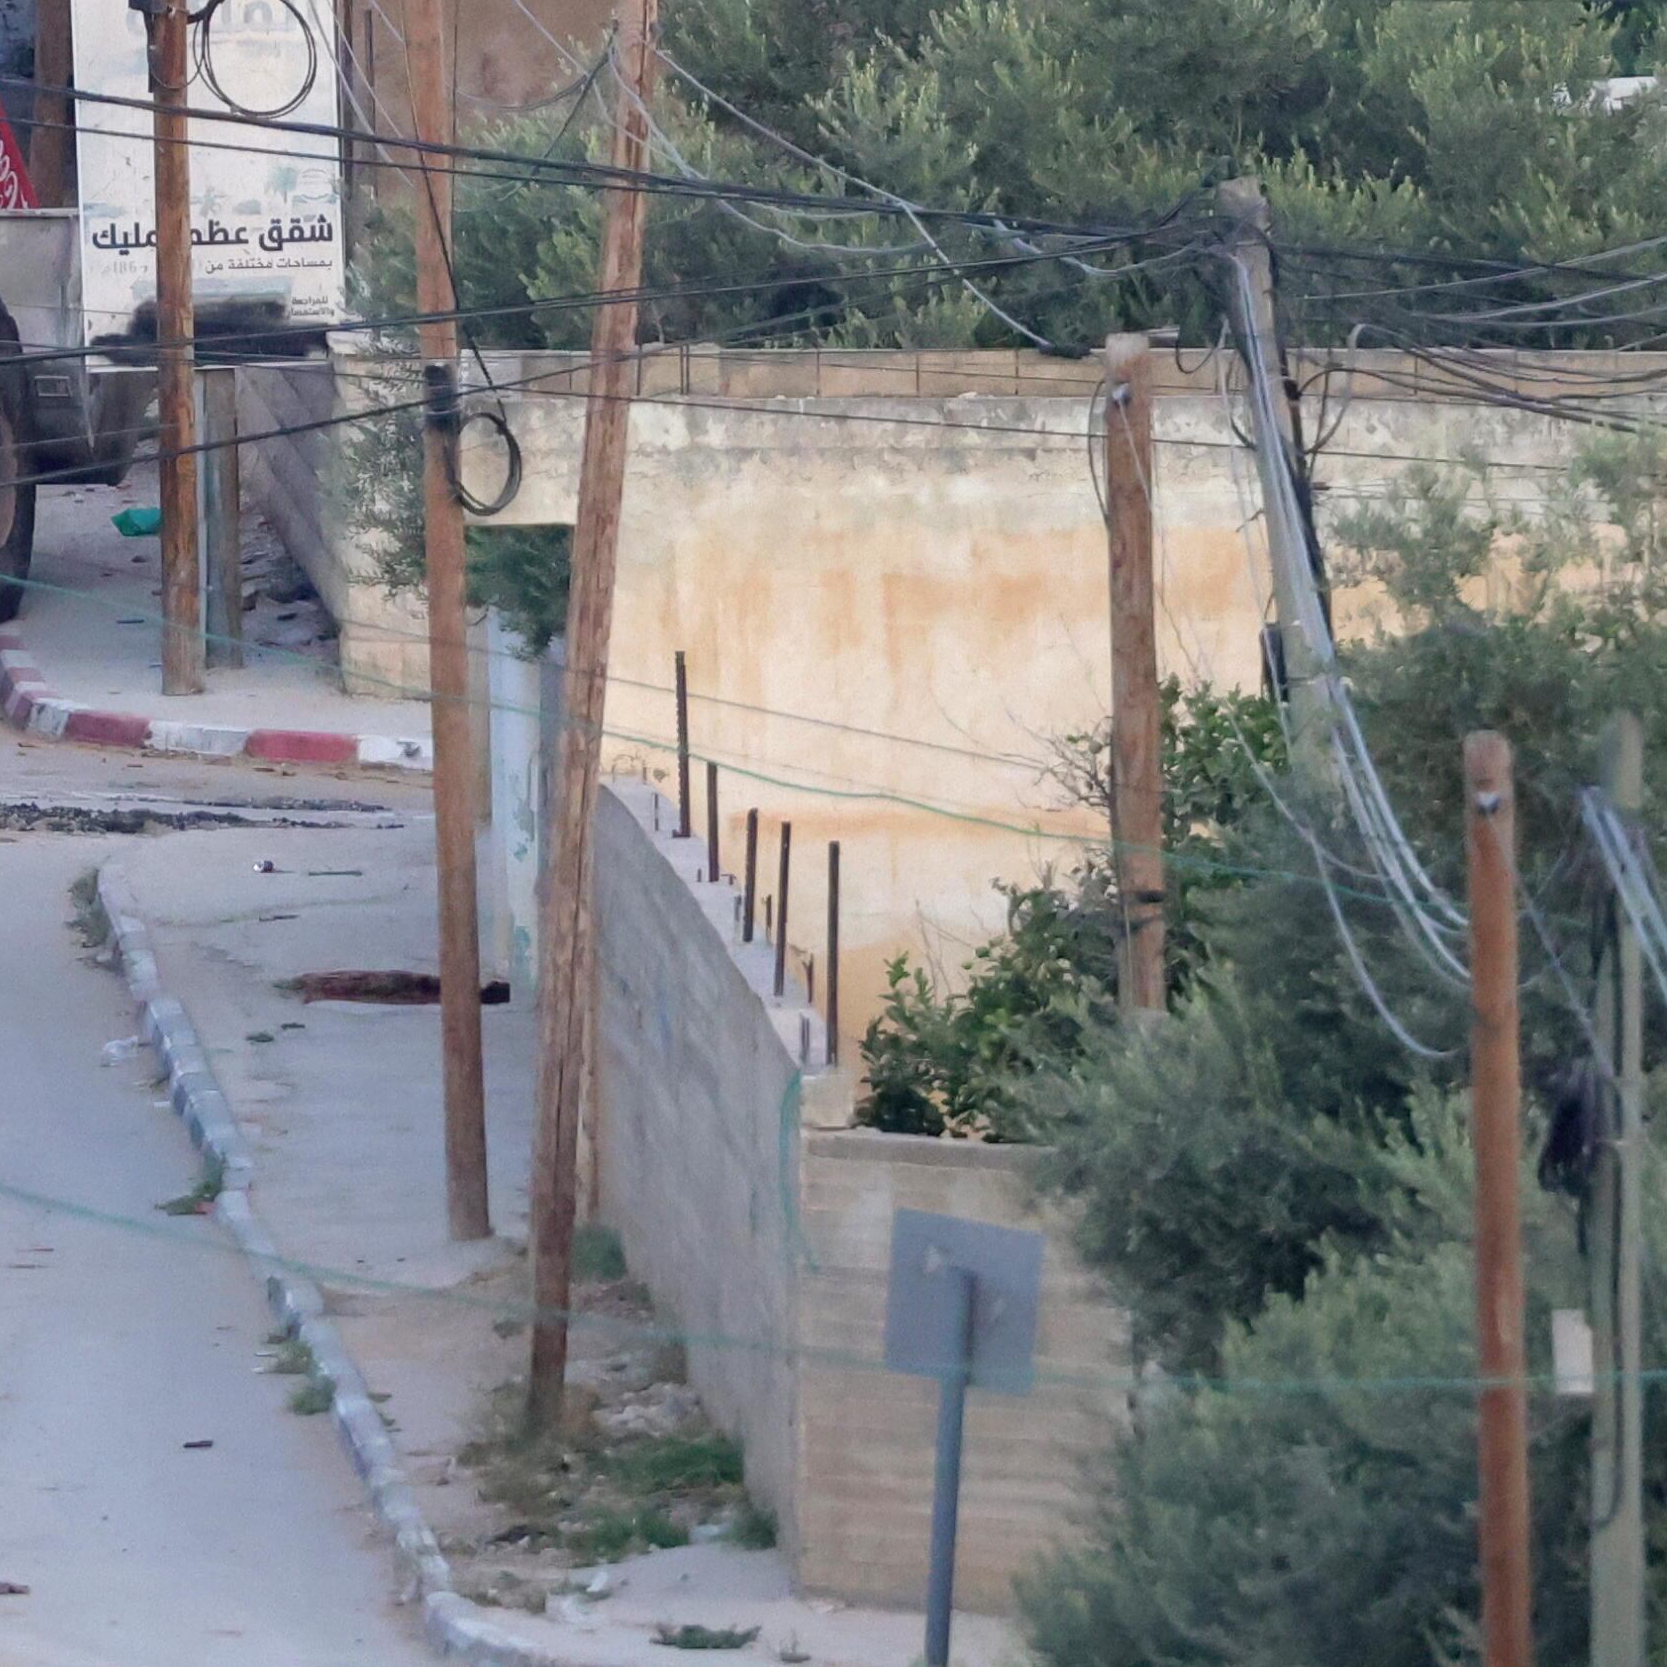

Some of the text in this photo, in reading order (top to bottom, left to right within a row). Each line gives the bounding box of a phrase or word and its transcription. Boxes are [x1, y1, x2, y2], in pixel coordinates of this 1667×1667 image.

[259, 213, 333, 251] شقق
[205, 259, 224, 274] من
[226, 258, 274, 271] مختلفة
[276, 257, 333, 271] بمساحات
